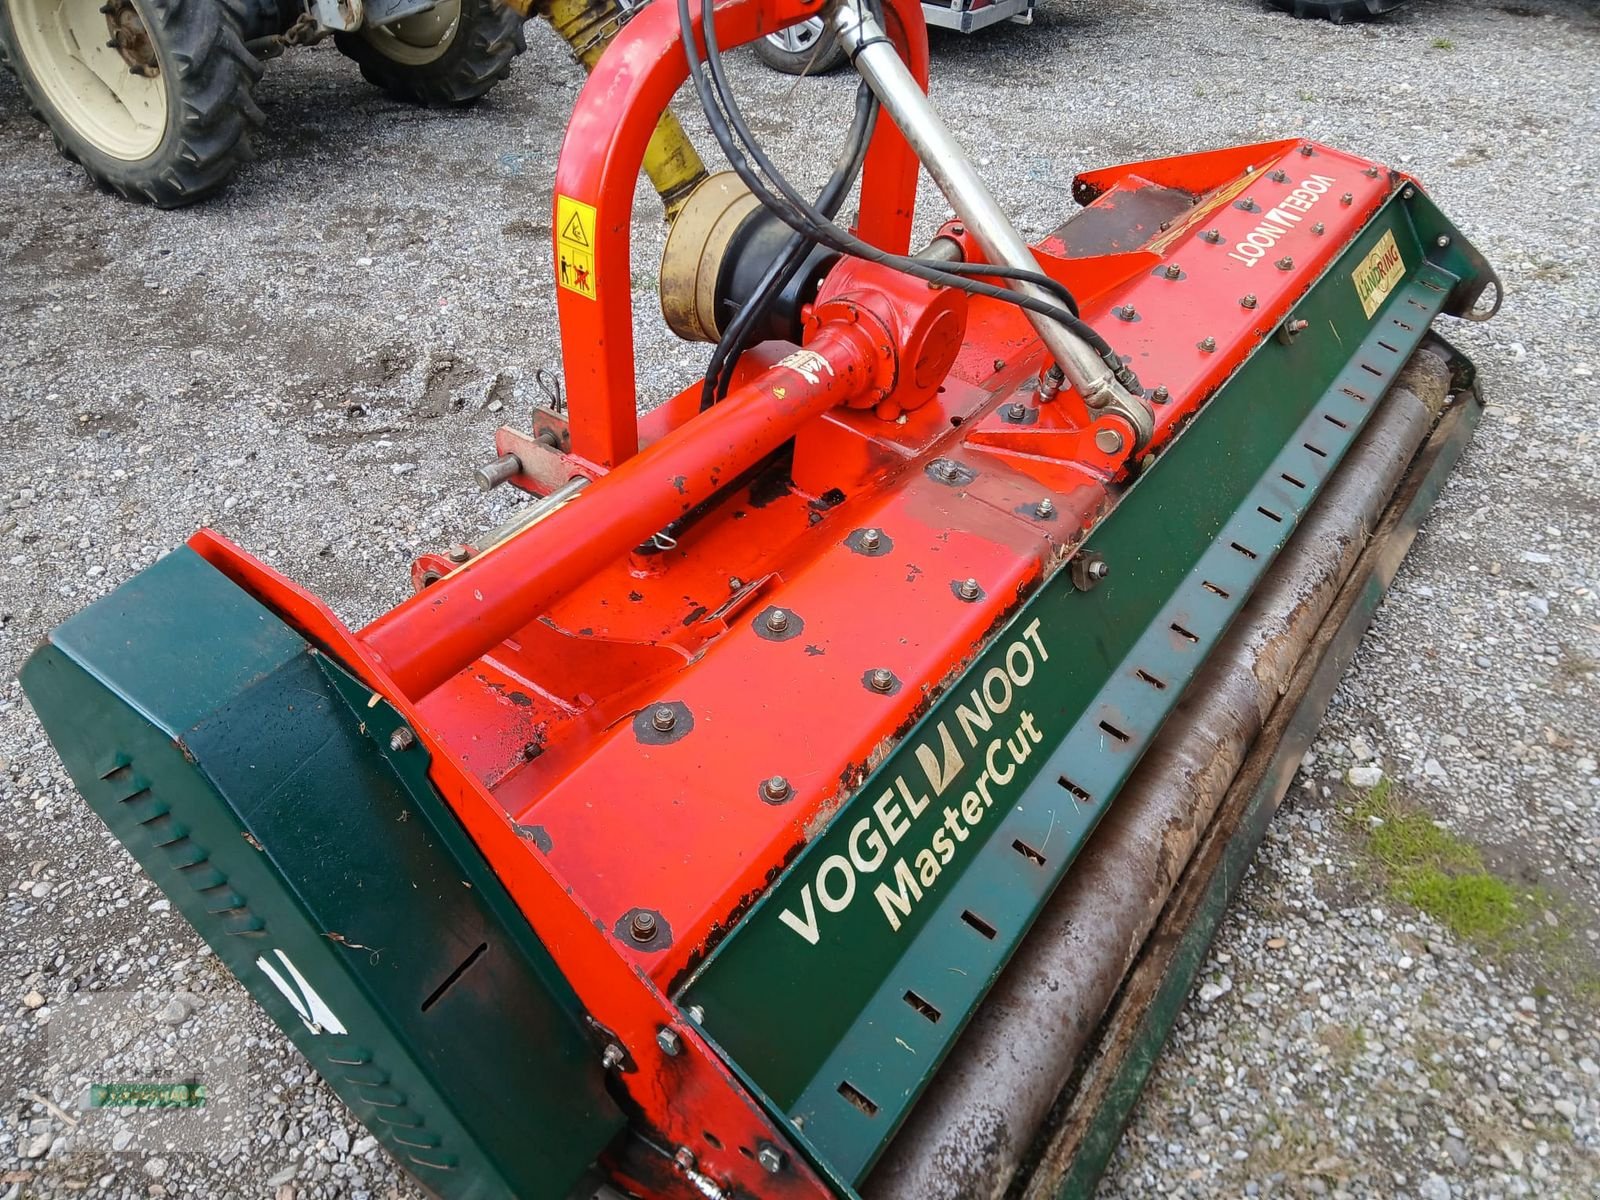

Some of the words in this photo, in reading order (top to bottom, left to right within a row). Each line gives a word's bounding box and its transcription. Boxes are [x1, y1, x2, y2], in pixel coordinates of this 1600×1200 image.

[1278, 173, 1337, 213] VOGEL
[1227, 221, 1287, 268] NOOT
[1358, 244, 1399, 301] LANDRING
[778, 775, 930, 946] VOGEL
[954, 617, 1049, 748] NOOT
[873, 709, 1043, 932] MasterCut
